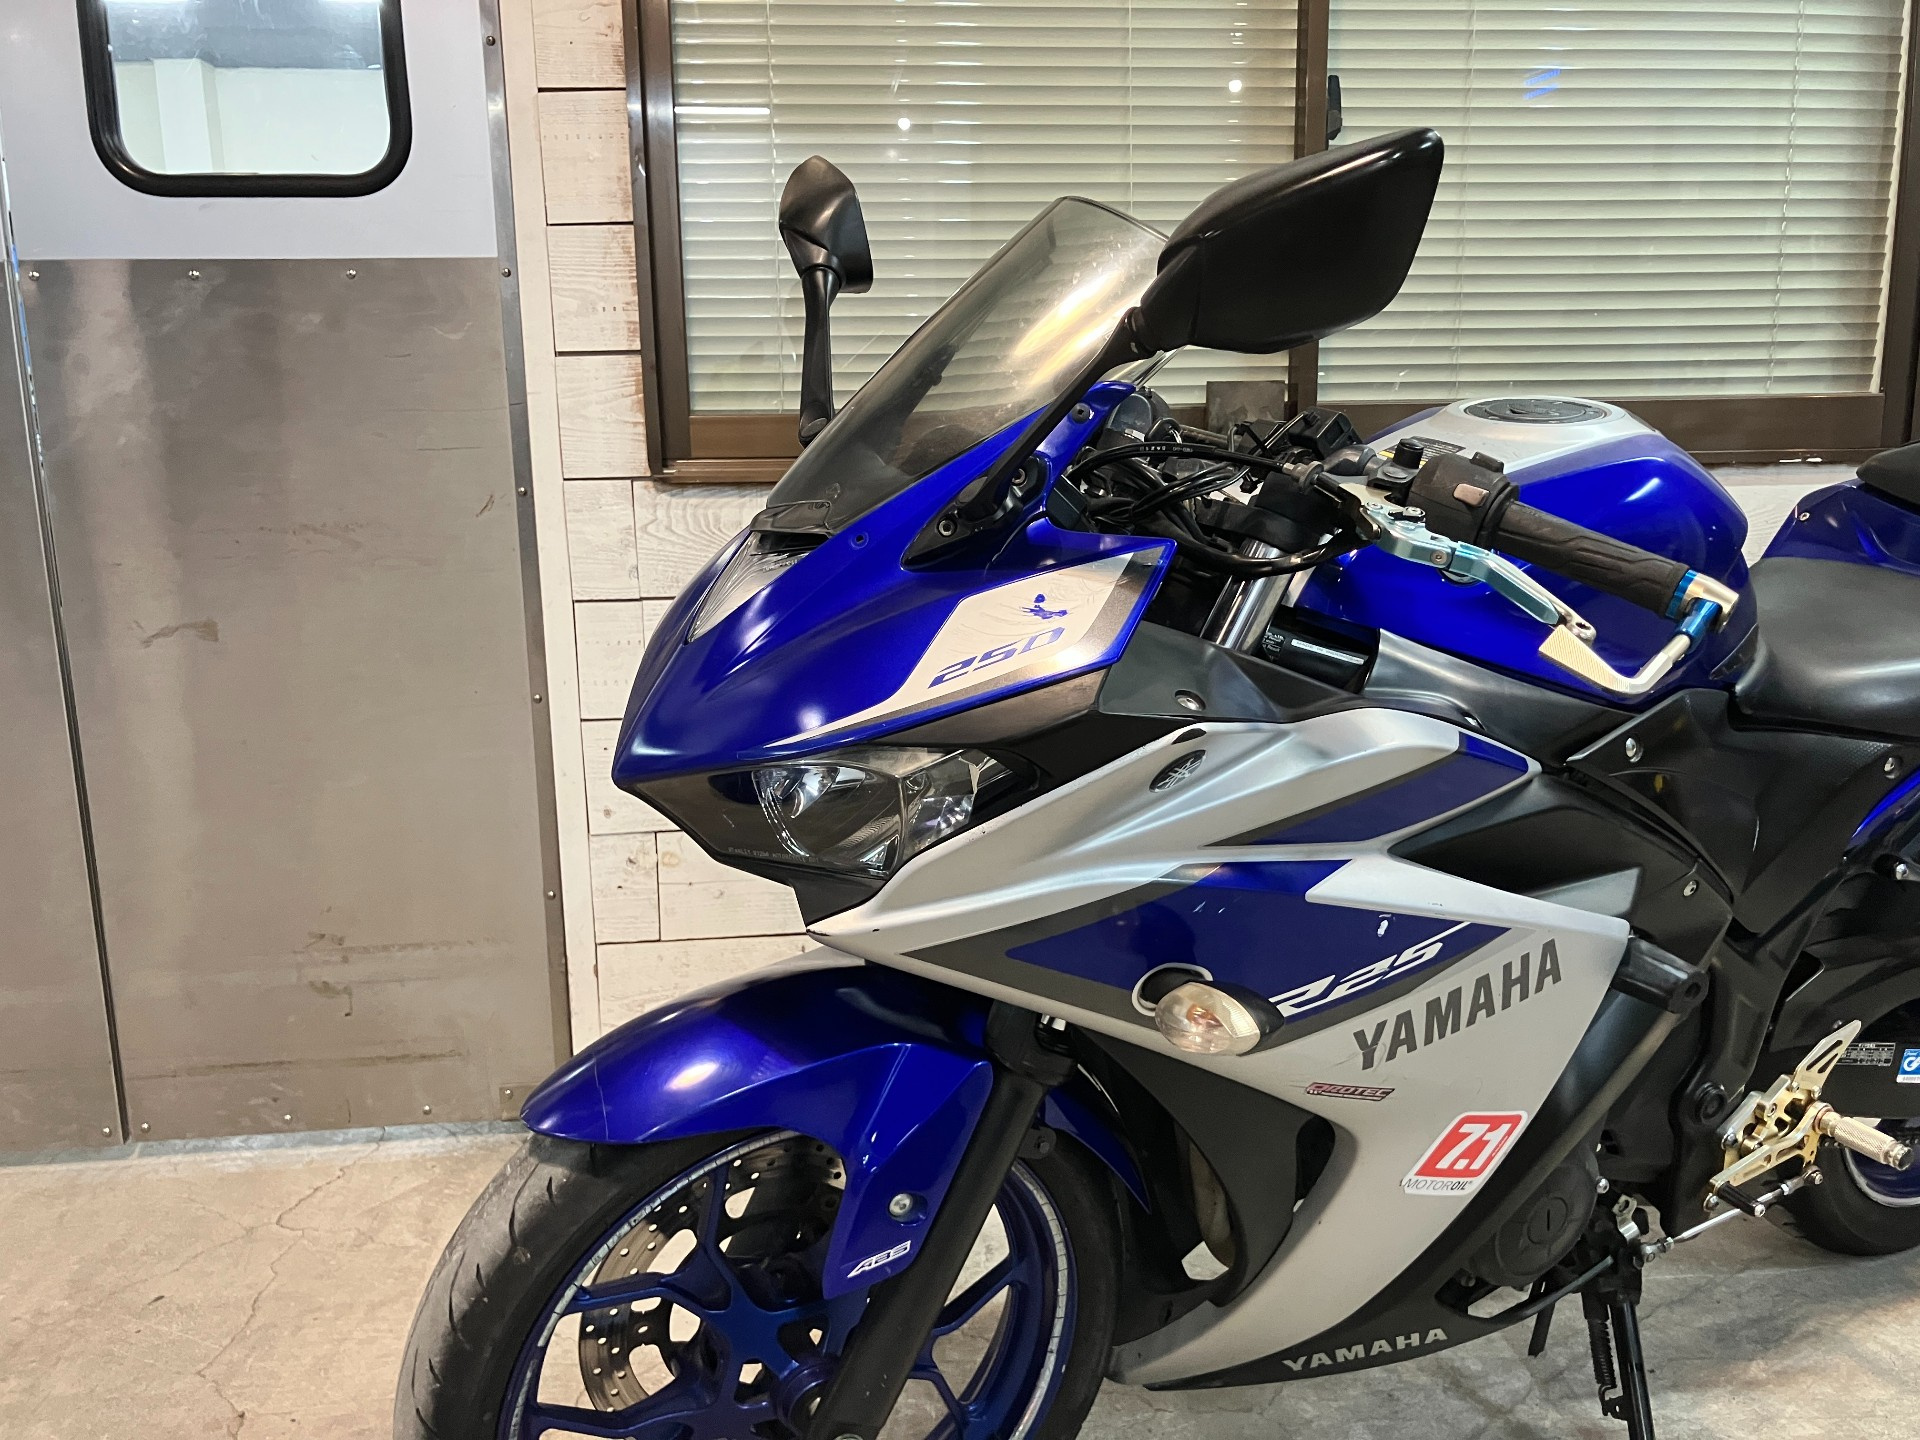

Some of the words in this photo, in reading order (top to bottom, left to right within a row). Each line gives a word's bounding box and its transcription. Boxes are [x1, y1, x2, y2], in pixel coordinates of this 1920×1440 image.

[928, 627, 1065, 689] 250
[1353, 938, 1562, 1071] YAMAHA
[1435, 1123, 1512, 1170] 7.1
[846, 1240, 911, 1278] ABS
[1282, 1328, 1448, 1371] YAMAHA
